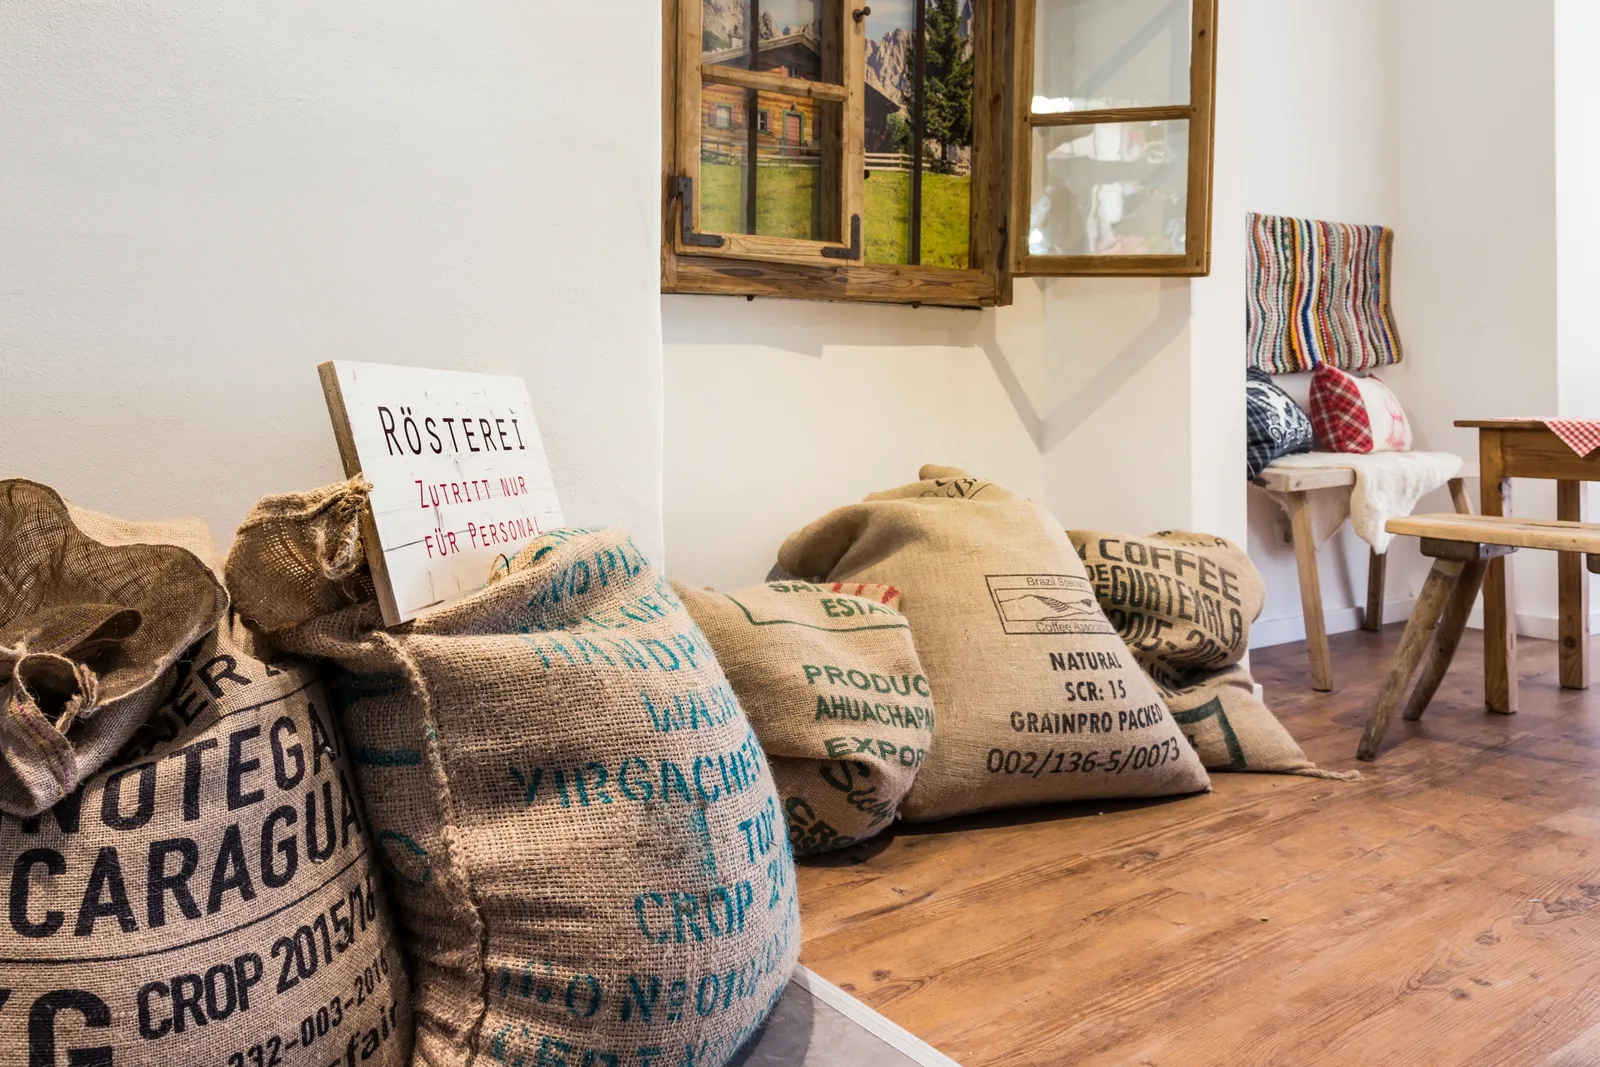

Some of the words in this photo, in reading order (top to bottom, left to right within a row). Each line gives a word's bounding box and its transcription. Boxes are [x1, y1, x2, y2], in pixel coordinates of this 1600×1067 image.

[378, 405, 526, 456] RÖSTEREI
[415, 480, 492, 508] ZUTRITT
[500, 476, 528, 497] NUR
[424, 528, 460, 559] FÜR
[467, 516, 544, 549] PERSONAL
[1099, 538, 1242, 607] COFFEE
[1049, 651, 1122, 671] NATURAL
[1108, 679, 1127, 700] 15
[1010, 710, 1113, 735] GRAINPRO
[1119, 702, 1164, 732] PACKED
[986, 736, 1181, 779] 002/136-5/0073
[634, 880, 753, 944] CROP
[136, 952, 263, 1041] CROP
[271, 874, 377, 995] 2015/16
